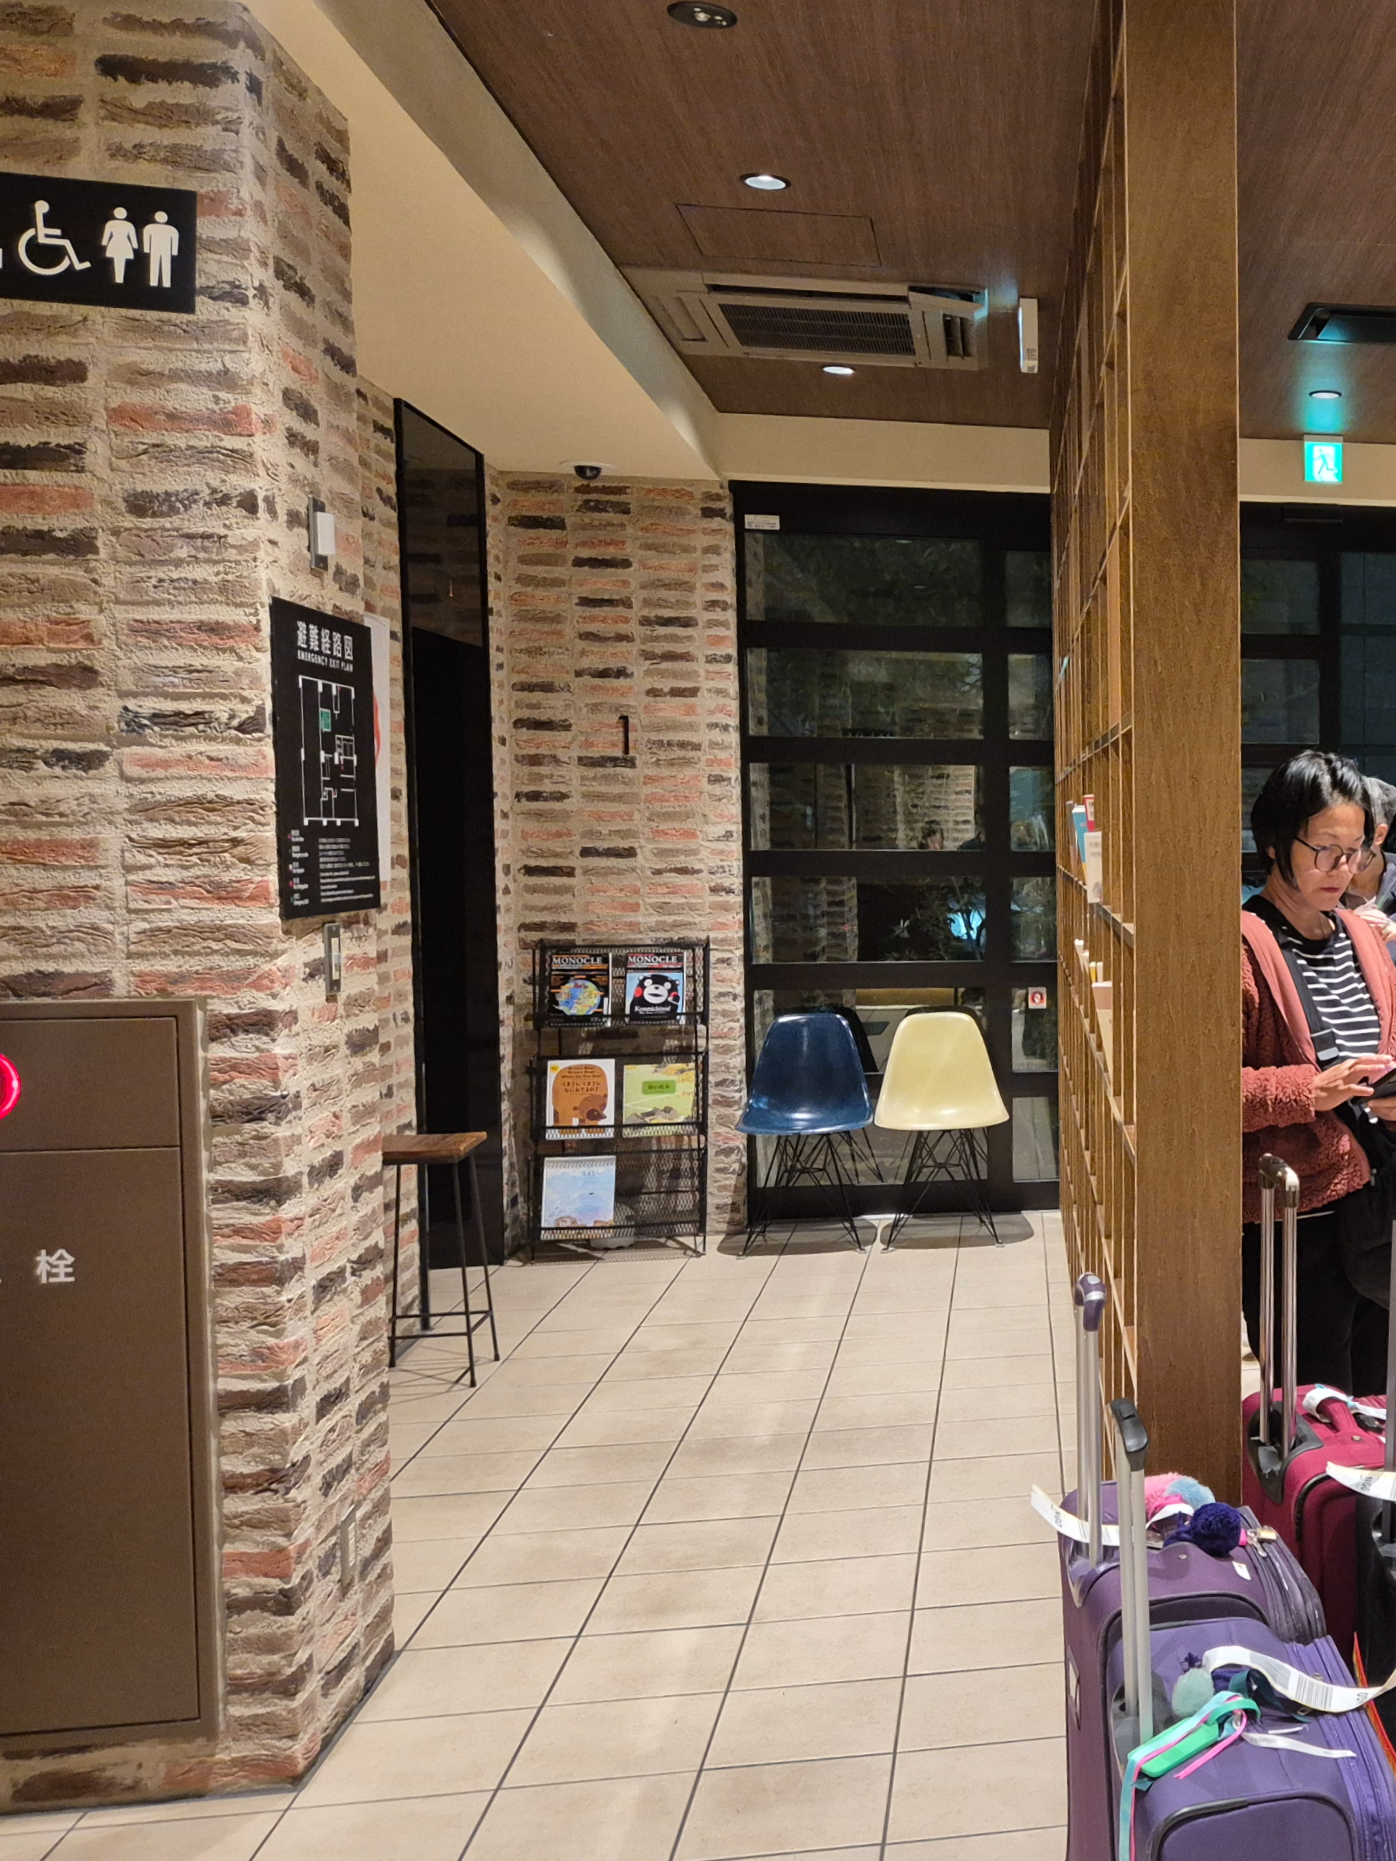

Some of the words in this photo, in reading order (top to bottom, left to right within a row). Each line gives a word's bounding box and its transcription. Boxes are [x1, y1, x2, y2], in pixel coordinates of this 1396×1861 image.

[297, 620, 354, 661] 避難経路図
[297, 649, 328, 666] EMERGENCY
[329, 657, 340, 669] EXIT
[341, 660, 354, 673] PLAN
[553, 956, 603, 965] MONOCLE
[628, 955, 678, 964] MONOCLE
[35, 1249, 76, 1284] 栓
